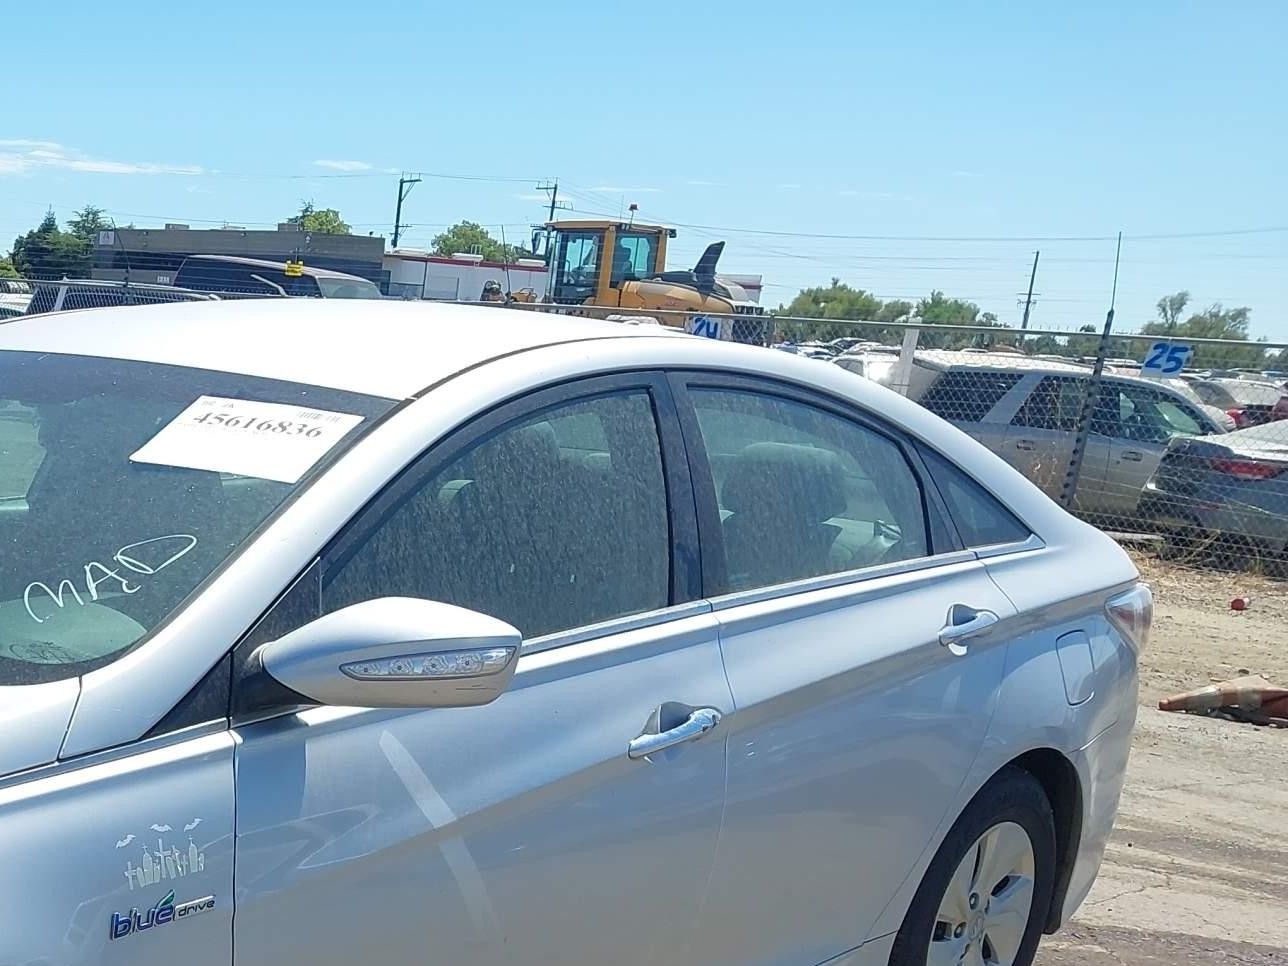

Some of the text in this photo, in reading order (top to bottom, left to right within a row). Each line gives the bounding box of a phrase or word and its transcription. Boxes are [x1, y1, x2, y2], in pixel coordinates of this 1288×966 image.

[1145, 343, 1189, 373] 25
[193, 412, 322, 439] 45616836
[110, 899, 216, 940] blue drive
